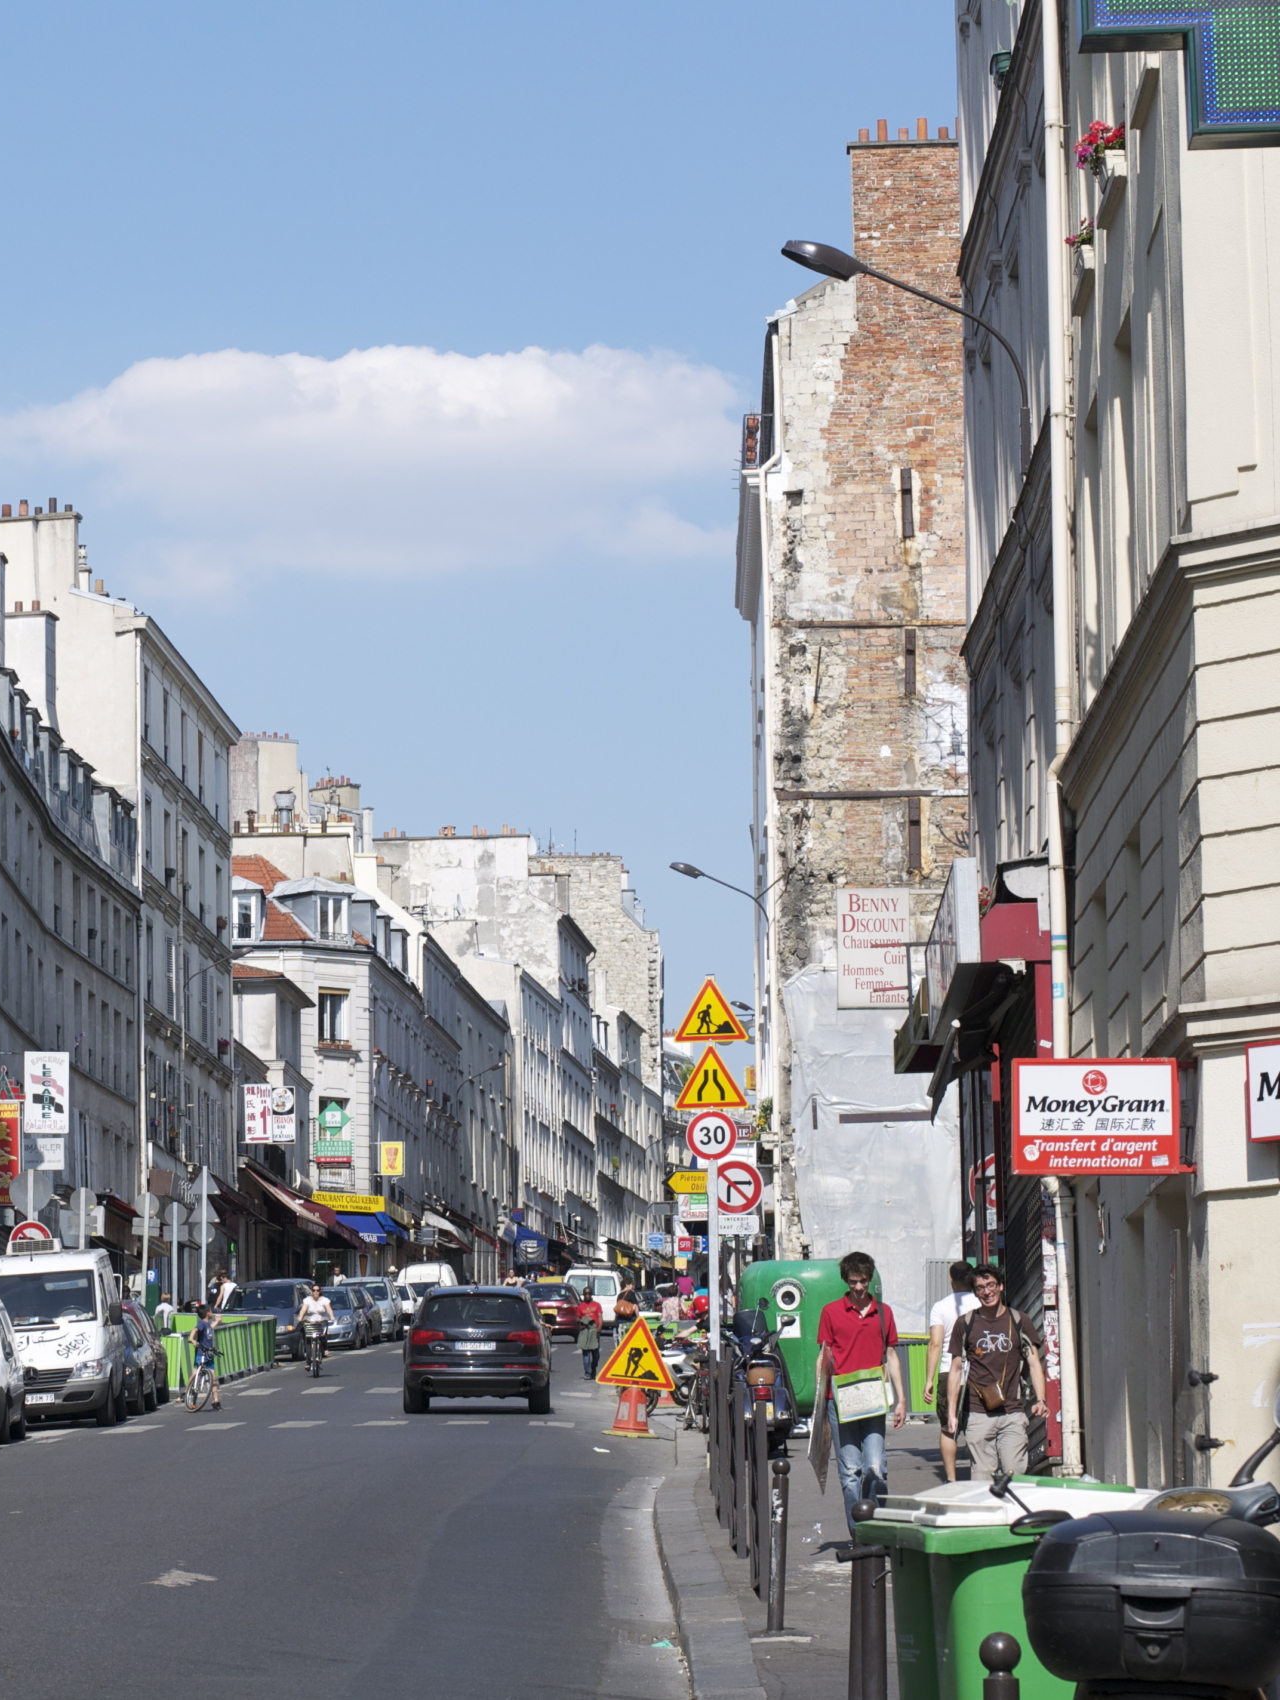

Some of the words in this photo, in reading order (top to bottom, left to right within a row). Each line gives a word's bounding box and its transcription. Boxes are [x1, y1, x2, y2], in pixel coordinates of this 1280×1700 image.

[847, 893, 900, 913] BENNY
[841, 913, 907, 933] DISCOUNT
[883, 950, 907, 965] Cuir
[842, 964, 885, 976] Hommes
[854, 977, 894, 991] Femmes
[869, 990, 906, 1004] Enfants
[256, 1085, 271, 1098] Photo
[1025, 1095, 1166, 1117] MoneyGram
[1039, 1117, 1086, 1132] 速汇金
[1094, 1117, 1157, 1132] 国际汇款
[699, 1125, 726, 1146] 30
[1033, 1138, 1097, 1152] Transfert
[1100, 1137, 1158, 1155] d'argent
[1048, 1154, 1144, 1168] international
[679, 1174, 706, 1182] Piétons
[361, 1196, 380, 1205] KEBAB
[679, 1240, 692, 1249] SFR
